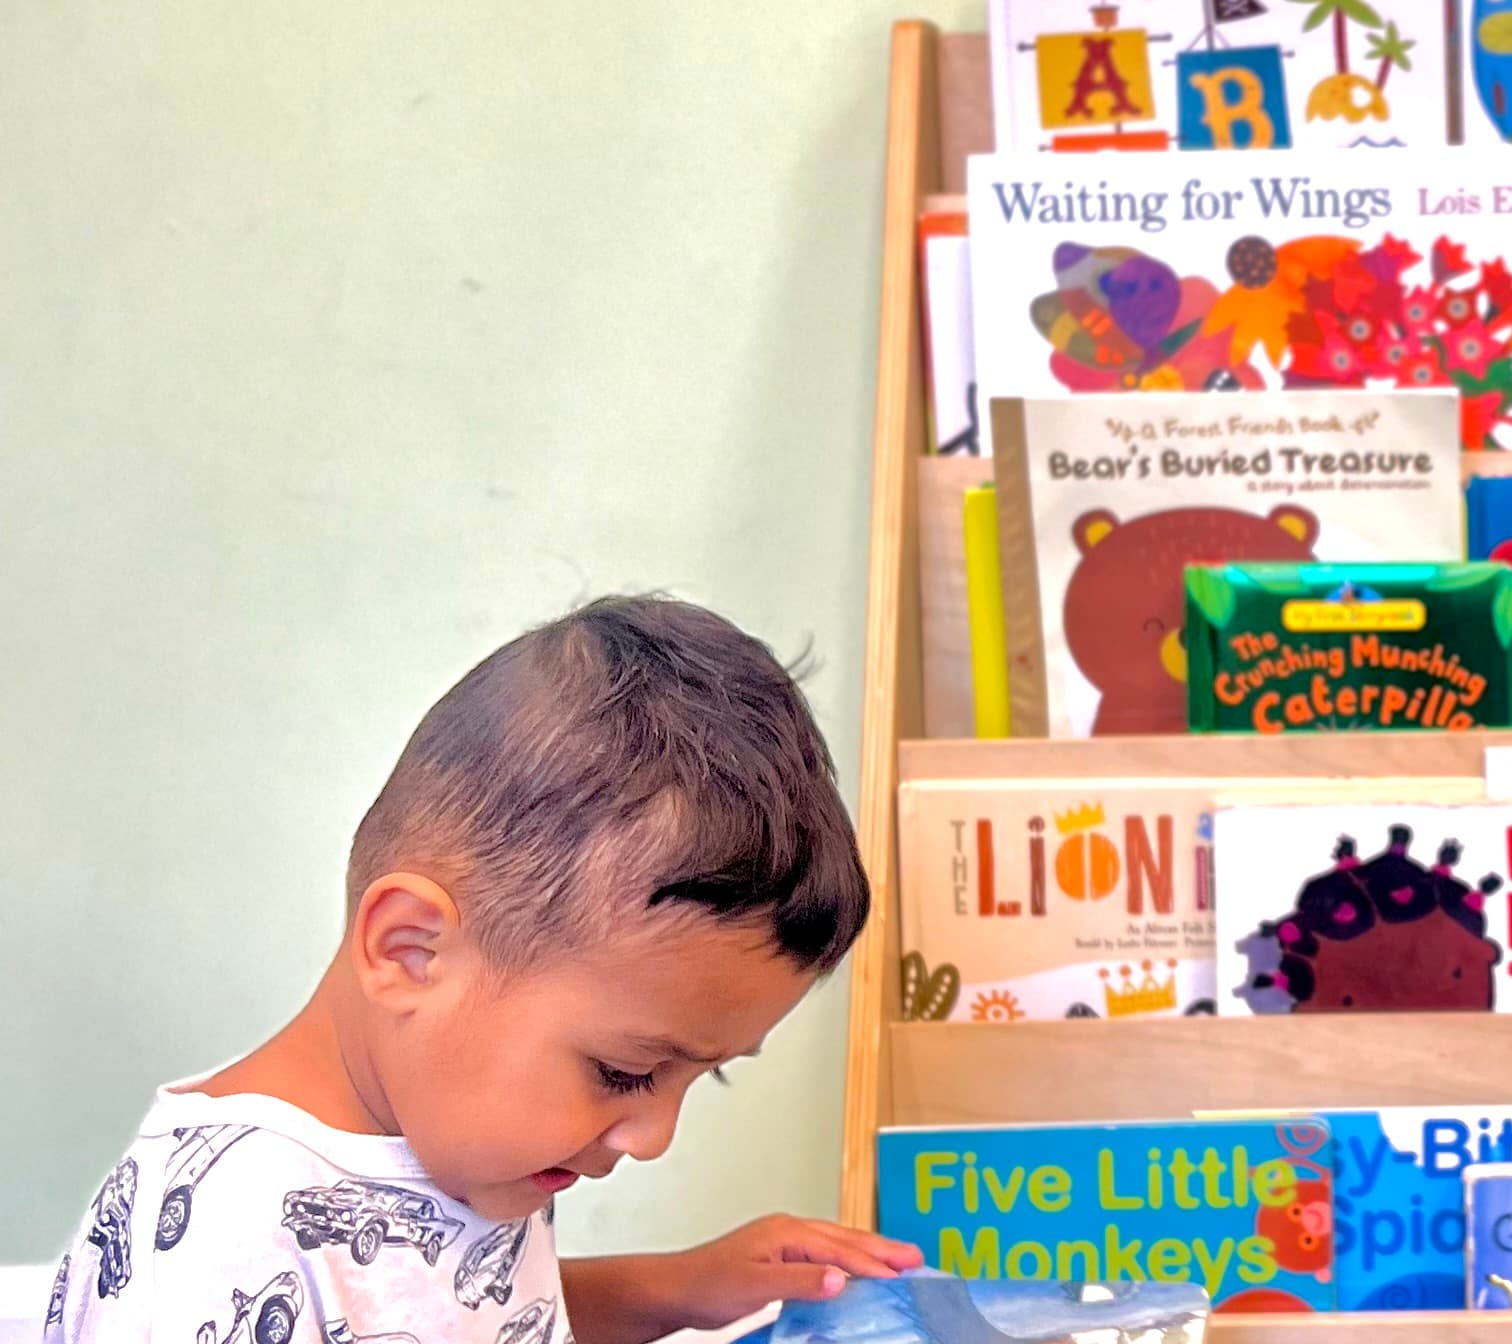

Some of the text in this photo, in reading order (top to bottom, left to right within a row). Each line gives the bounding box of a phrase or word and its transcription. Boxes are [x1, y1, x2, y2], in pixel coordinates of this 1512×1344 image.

[1064, 37, 1274, 149] A B
[994, 177, 1393, 232] Waiting for Wings
[1416, 187, 1481, 216] Lois
[1164, 419, 1222, 438] Forest
[1228, 415, 1295, 437] Friends
[1299, 415, 1345, 434] Book
[1049, 445, 1434, 480] Bear's Buried Treasure
[1214, 634, 1488, 706] Crunching Munching
[1229, 631, 1279, 662] The
[1252, 674, 1487, 734] Caterpilla
[914, 1144, 1298, 1214] Five Little
[939, 1223, 1279, 1299] Monkeys
